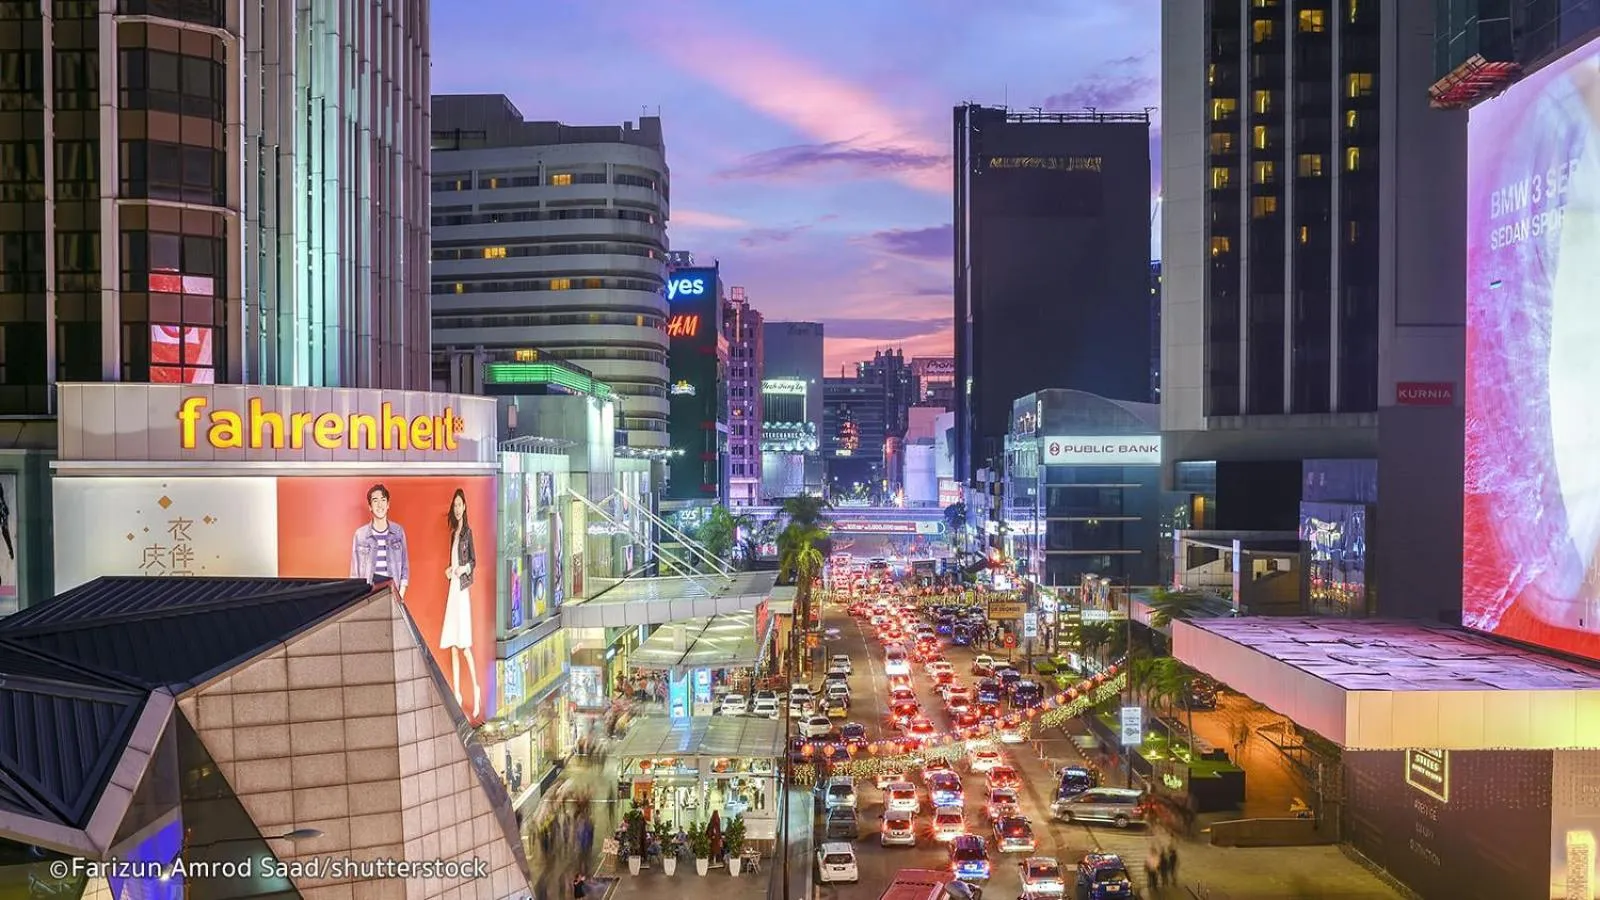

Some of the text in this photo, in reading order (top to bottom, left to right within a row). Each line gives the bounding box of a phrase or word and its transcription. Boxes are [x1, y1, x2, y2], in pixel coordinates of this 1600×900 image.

[1491, 179, 1529, 219] BMW
[1532, 174, 1541, 203] 3
[1491, 218, 1529, 250] SEDAN
[668, 279, 704, 300] yes
[1399, 389, 1451, 398] KURNIA
[1065, 445, 1158, 453] PUBLIC BANK
